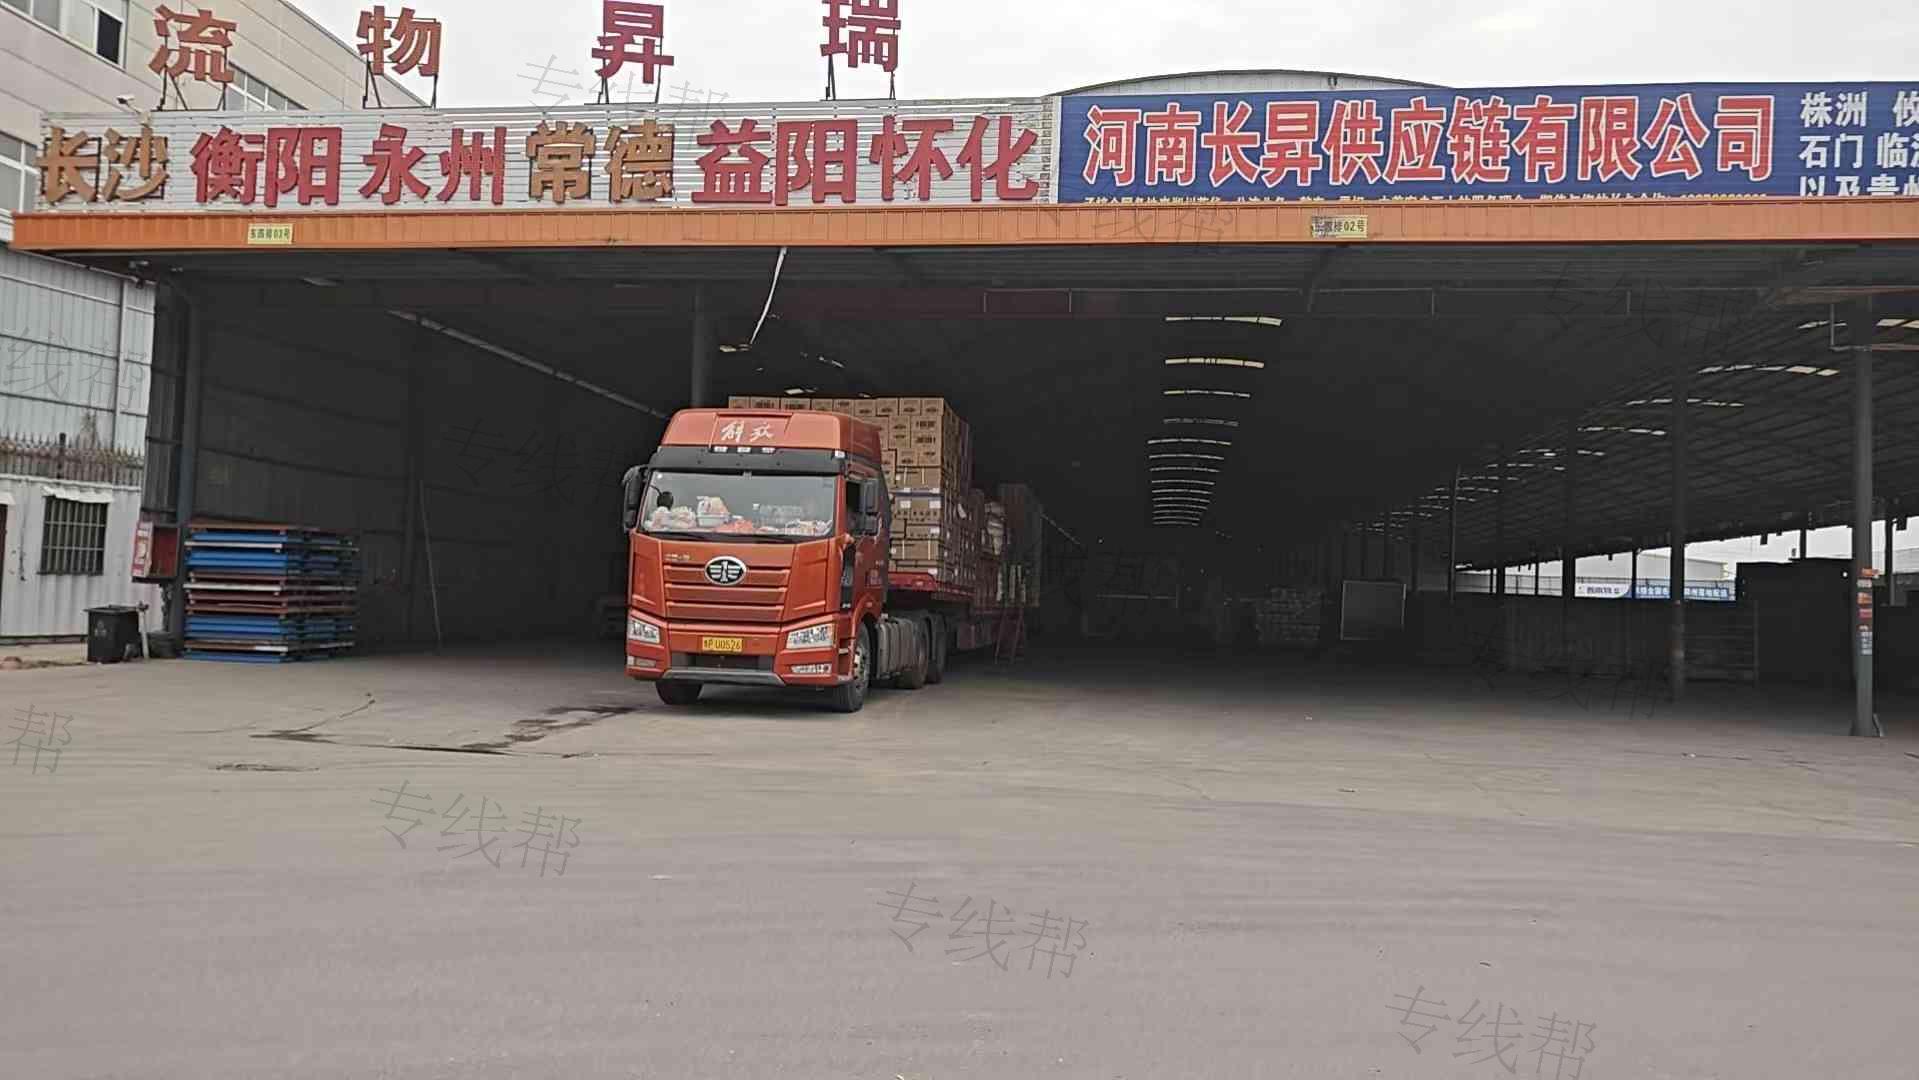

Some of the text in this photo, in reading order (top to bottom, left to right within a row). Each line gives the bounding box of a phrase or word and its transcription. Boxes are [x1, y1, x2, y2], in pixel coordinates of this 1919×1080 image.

[147, 0, 901, 83] 流 物 昇 瑞
[1082, 93, 1774, 188] 河南长昇供应链有限公司
[1798, 132, 1919, 169] 石门 临
[1799, 91, 1868, 128] 株洲
[36, 115, 1039, 207] 长沙 衡阳 永州 常德 益阳 怀化
